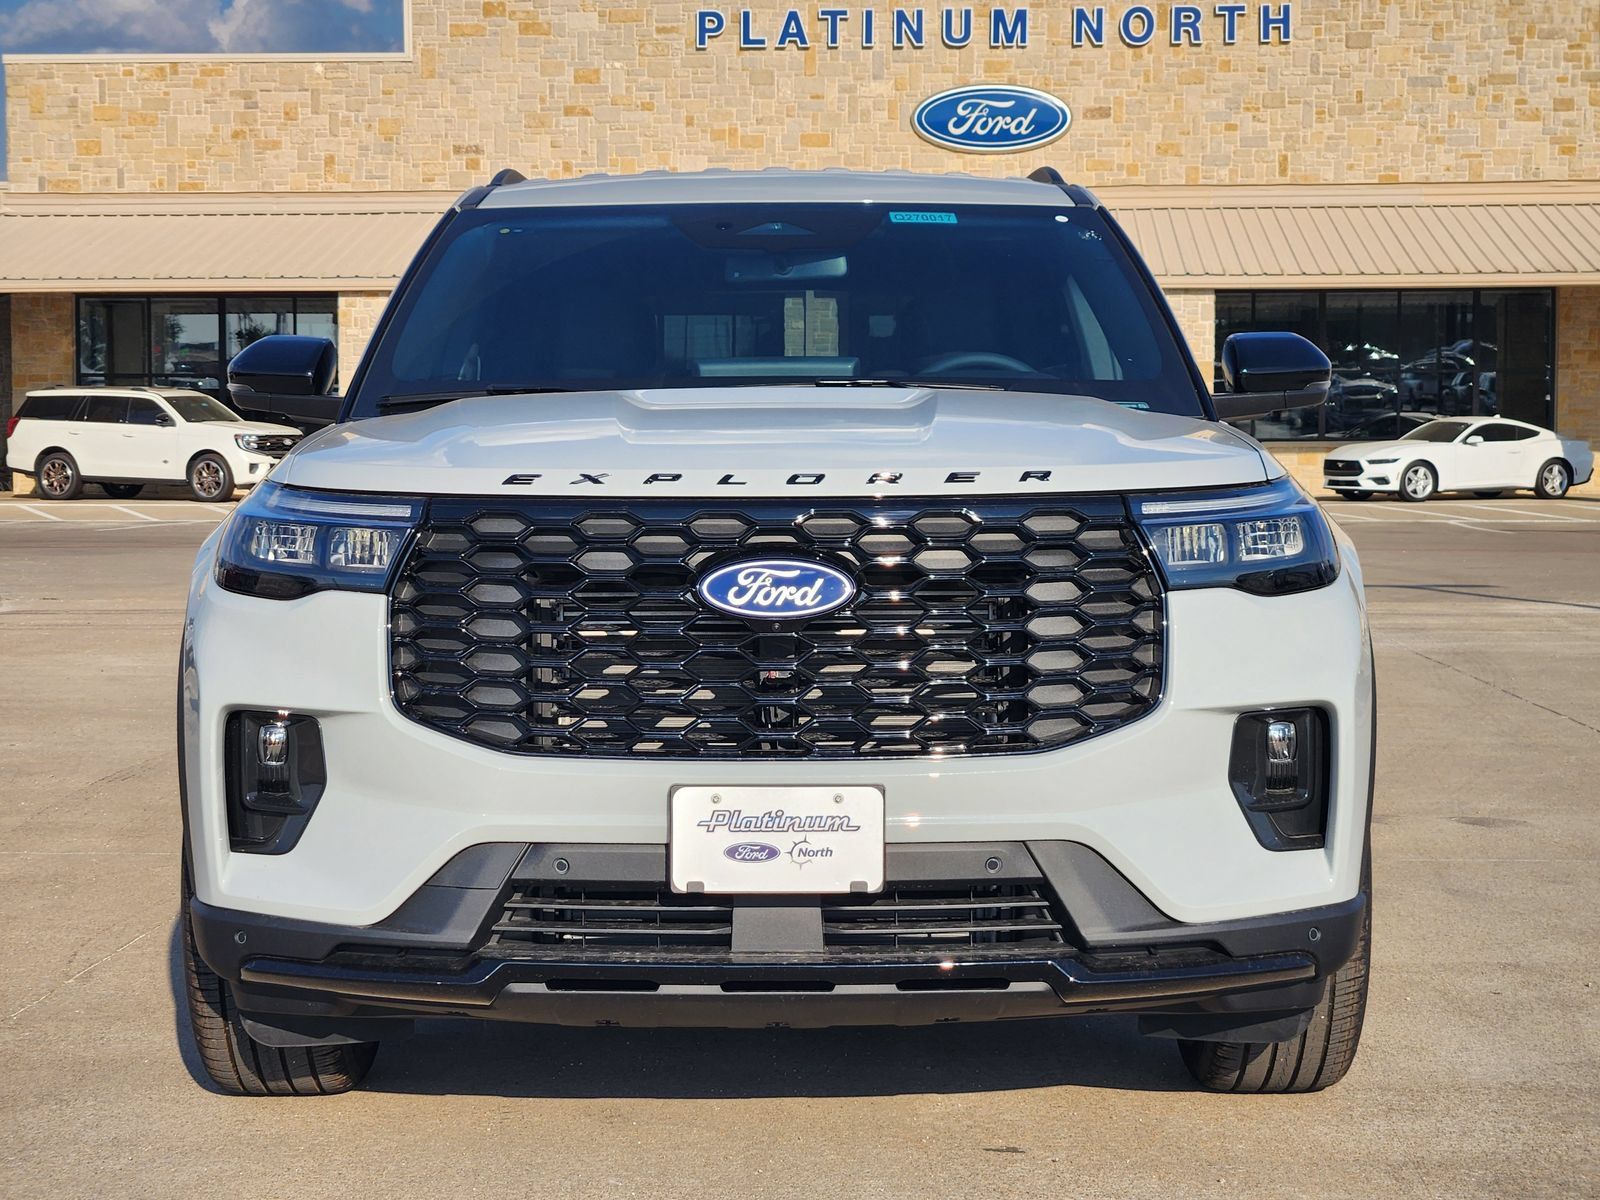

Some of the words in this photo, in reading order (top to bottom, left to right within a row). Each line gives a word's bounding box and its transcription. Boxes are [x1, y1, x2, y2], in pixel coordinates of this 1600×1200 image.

[696, 8, 1028, 49] PLATINUM
[1072, 3, 1292, 46] NORTH
[947, 98, 1038, 136] Ford
[501, 470, 1052, 486] EXPLORER
[727, 567, 825, 606] Ford
[697, 809, 861, 833] Platinum
[734, 843, 770, 861] Ford
[797, 846, 834, 858] North
